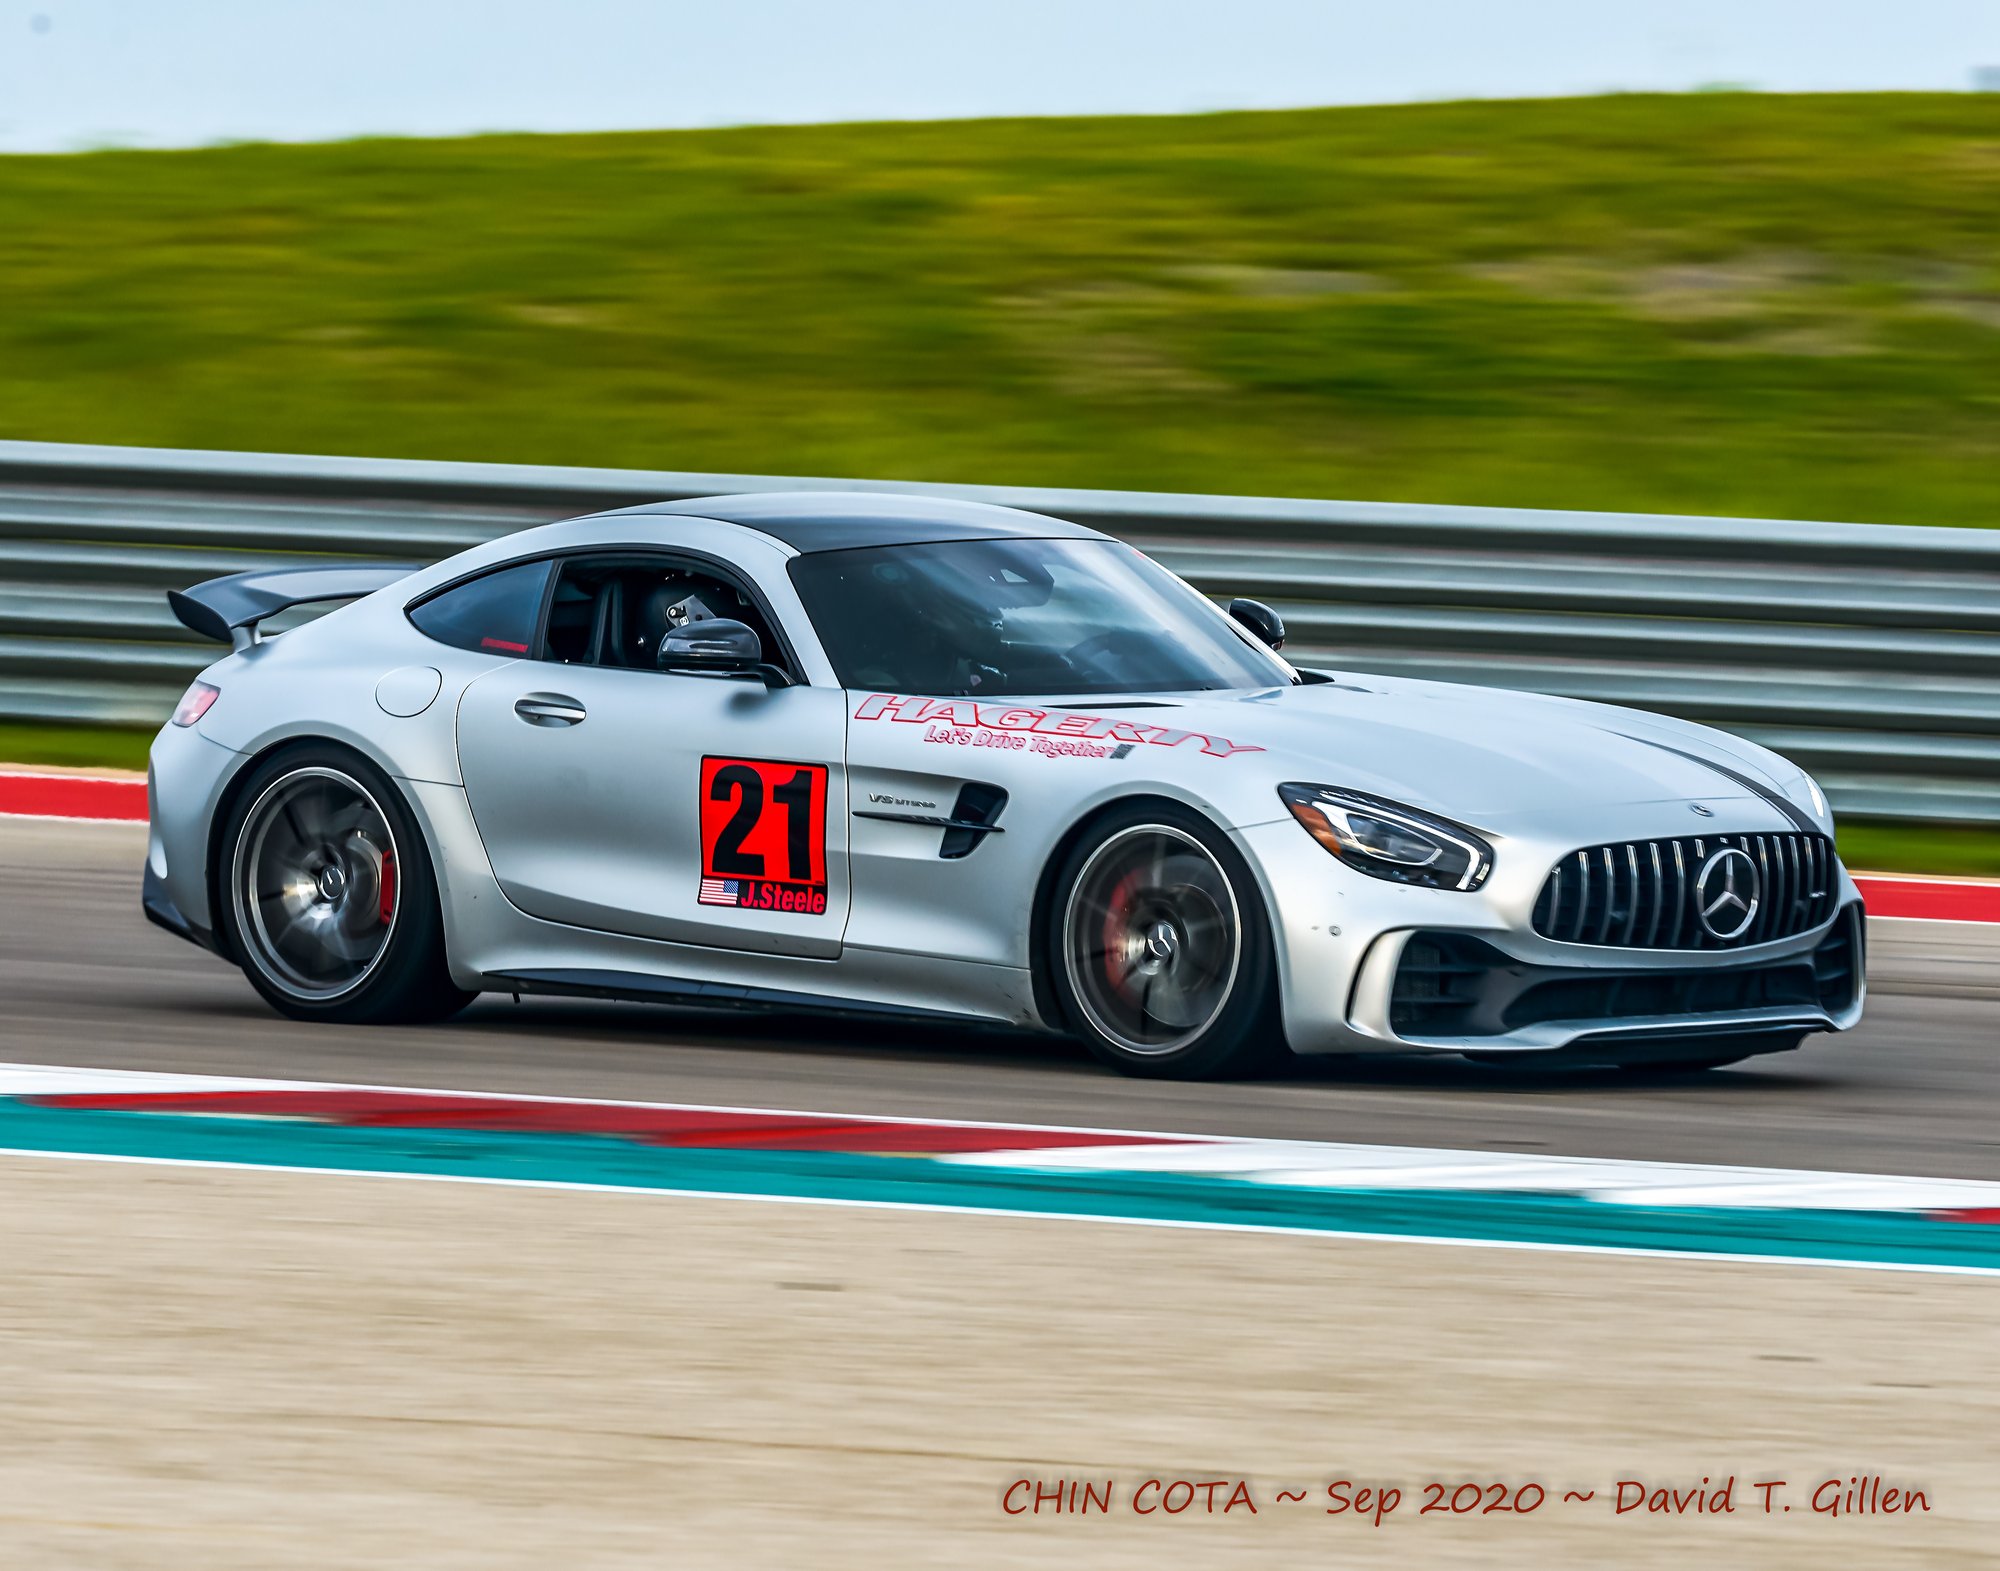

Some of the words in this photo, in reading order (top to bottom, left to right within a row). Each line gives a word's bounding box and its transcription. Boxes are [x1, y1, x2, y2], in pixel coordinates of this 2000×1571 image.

[854, 694, 1267, 758] HAGERTY
[924, 725, 973, 745] Let's
[973, 729, 1026, 750] Drive
[1029, 735, 1115, 759] Together
[711, 764, 813, 881] 21
[741, 881, 825, 913] J.Steele
